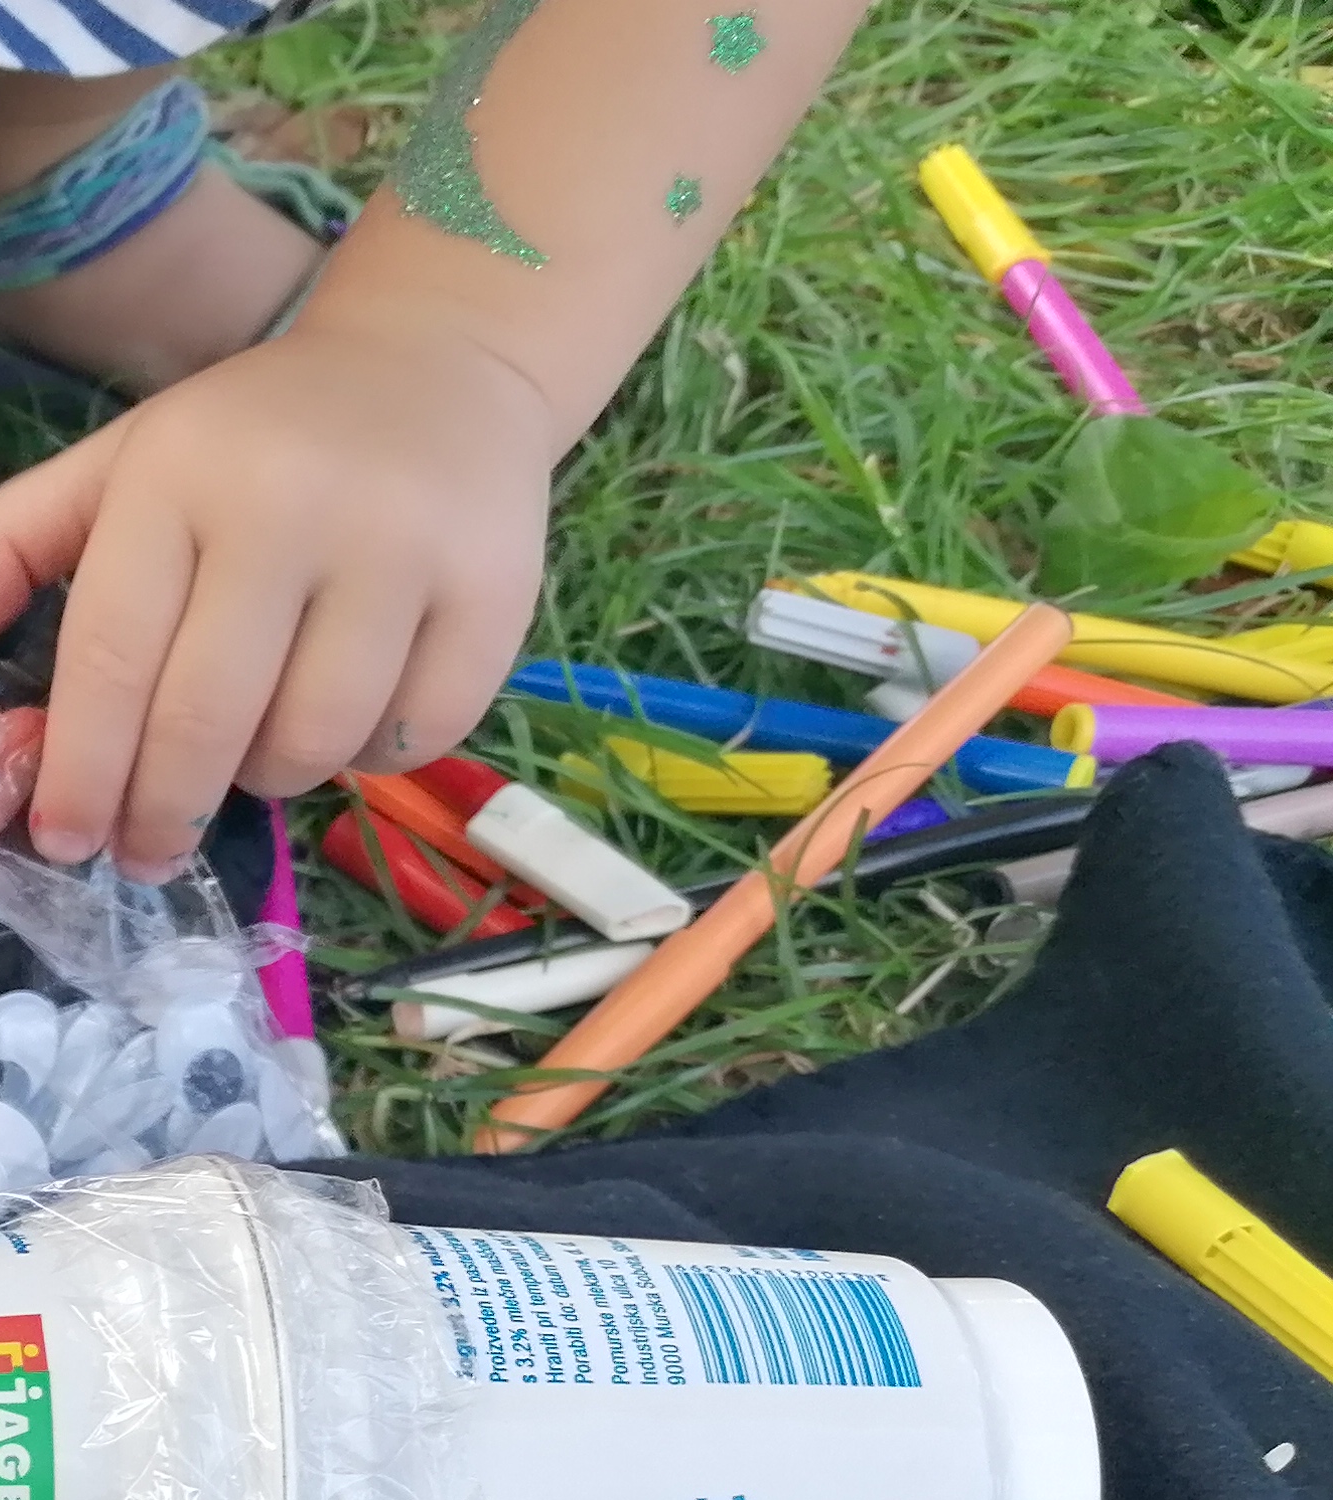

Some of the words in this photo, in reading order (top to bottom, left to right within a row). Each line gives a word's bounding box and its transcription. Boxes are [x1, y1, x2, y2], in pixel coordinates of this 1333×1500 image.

[543, 1264, 571, 1299] datum
[596, 1259, 620, 1270] 10
[471, 1286, 489, 1297] iz
[497, 1278, 525, 1323] mlečne
[610, 1274, 635, 1300] ulica
[531, 1311, 558, 1329] pri
[559, 1302, 579, 1322] do:
[646, 1292, 675, 1339] Murska
[479, 1301, 509, 1382] Proizveden
[509, 1328, 535, 1368] 3,2%
[537, 1333, 566, 1384] Hraniti
[563, 1326, 594, 1384] Porabiti
[599, 1312, 631, 1385] Pomurske
[624, 1303, 659, 1385] Industrijska
[522, 1374, 538, 1384] s
[660, 1344, 687, 1386] 9000
